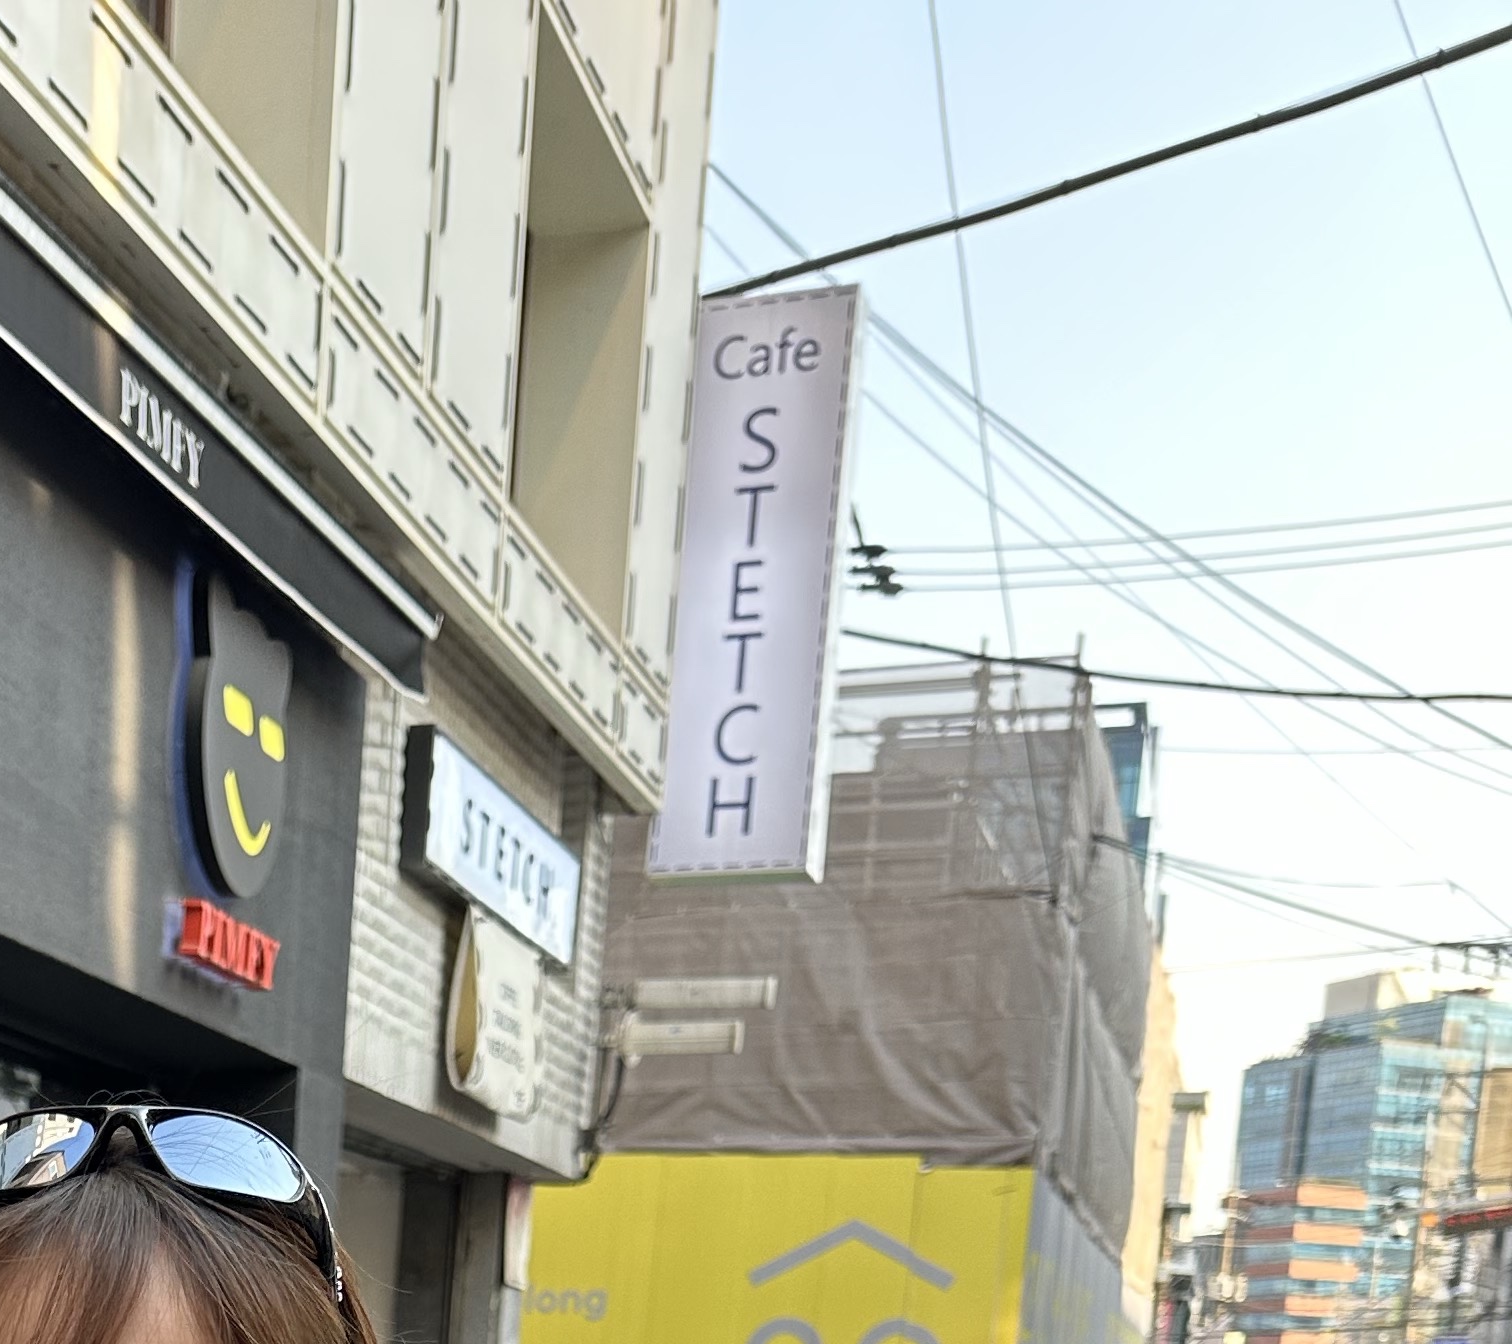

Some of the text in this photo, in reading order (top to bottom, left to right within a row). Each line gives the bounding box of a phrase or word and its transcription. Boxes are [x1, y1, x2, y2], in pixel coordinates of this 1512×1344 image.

[712, 325, 822, 381] Cafe
[119, 367, 206, 490] PIMFY
[705, 406, 781, 838] STETCH
[460, 798, 556, 921] STETCH
[191, 898, 281, 991] PIMFY
